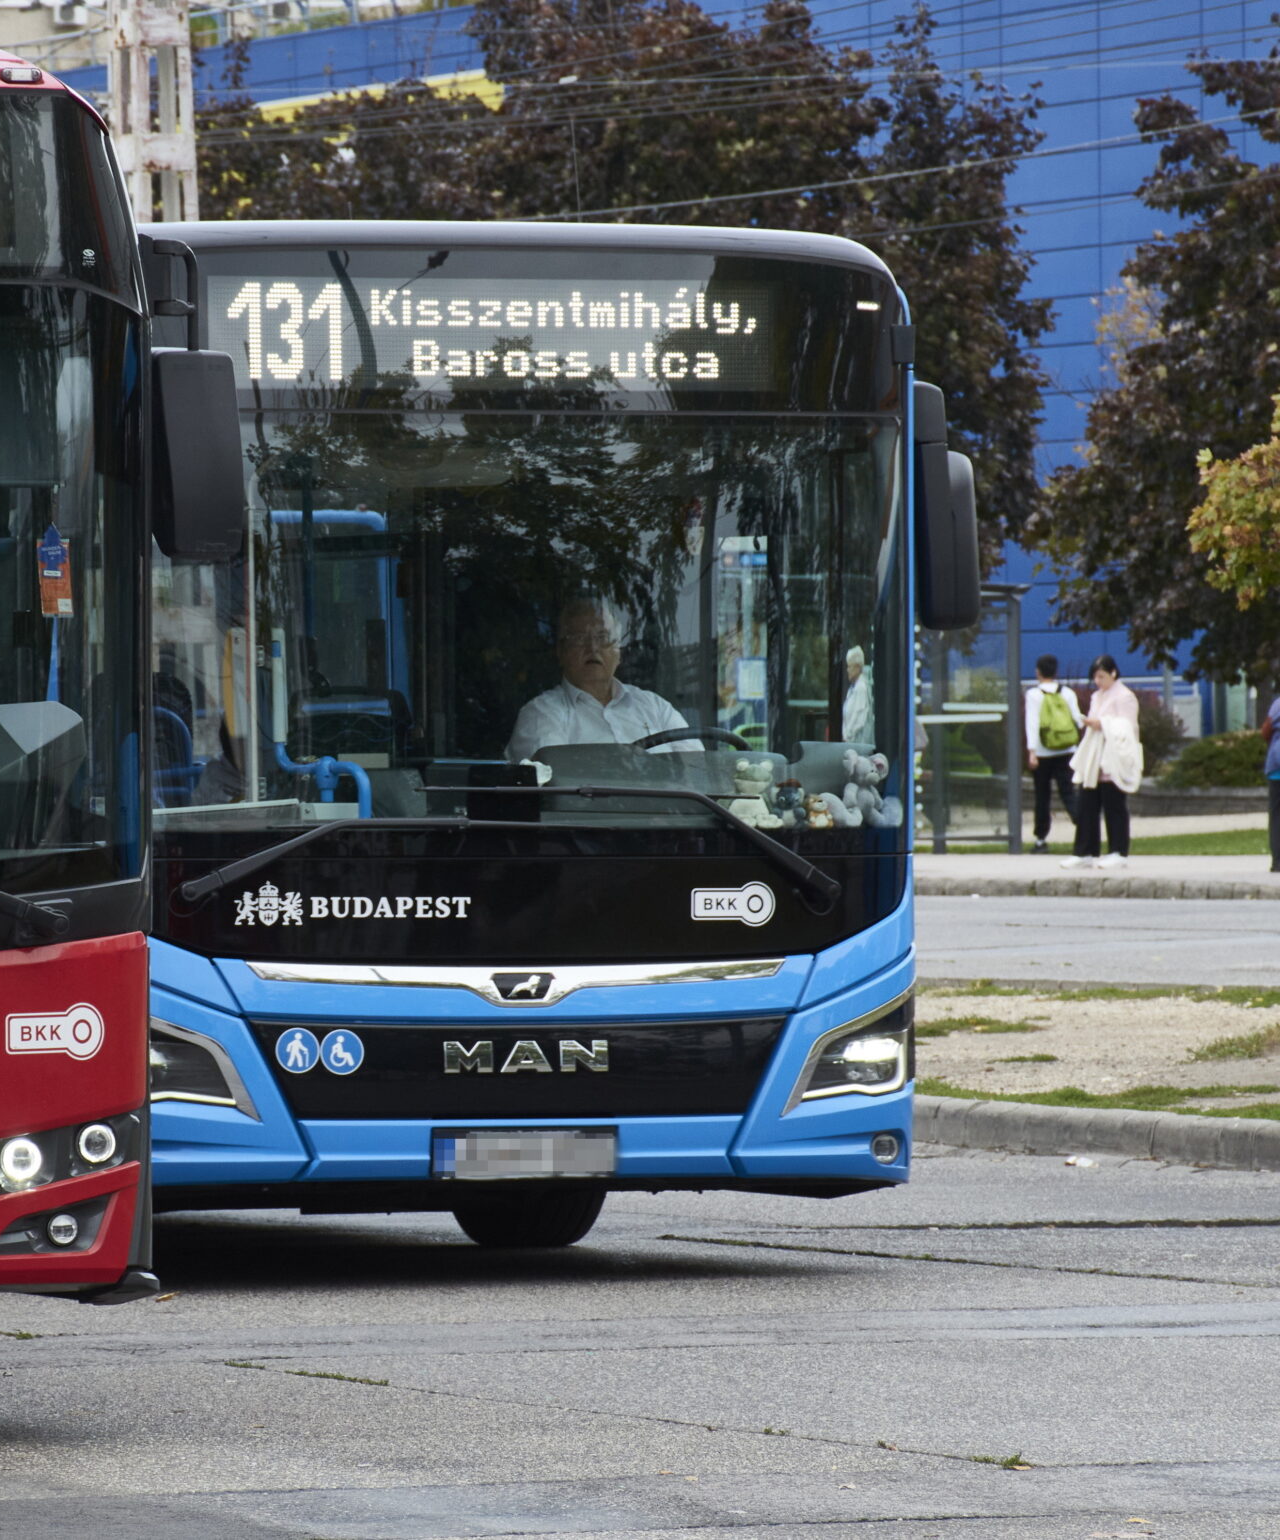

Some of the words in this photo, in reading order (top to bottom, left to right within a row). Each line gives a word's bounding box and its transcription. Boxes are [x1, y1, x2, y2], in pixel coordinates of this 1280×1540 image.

[370, 287, 757, 335] Kisszentmihály,
[226, 281, 343, 380] 131
[413, 339, 592, 378] Baross
[610, 341, 719, 379] utca
[310, 895, 471, 919] BUDAPEST
[703, 897, 738, 911] BKK
[20, 1024, 62, 1042] BKK
[443, 1039, 610, 1074] MAN
